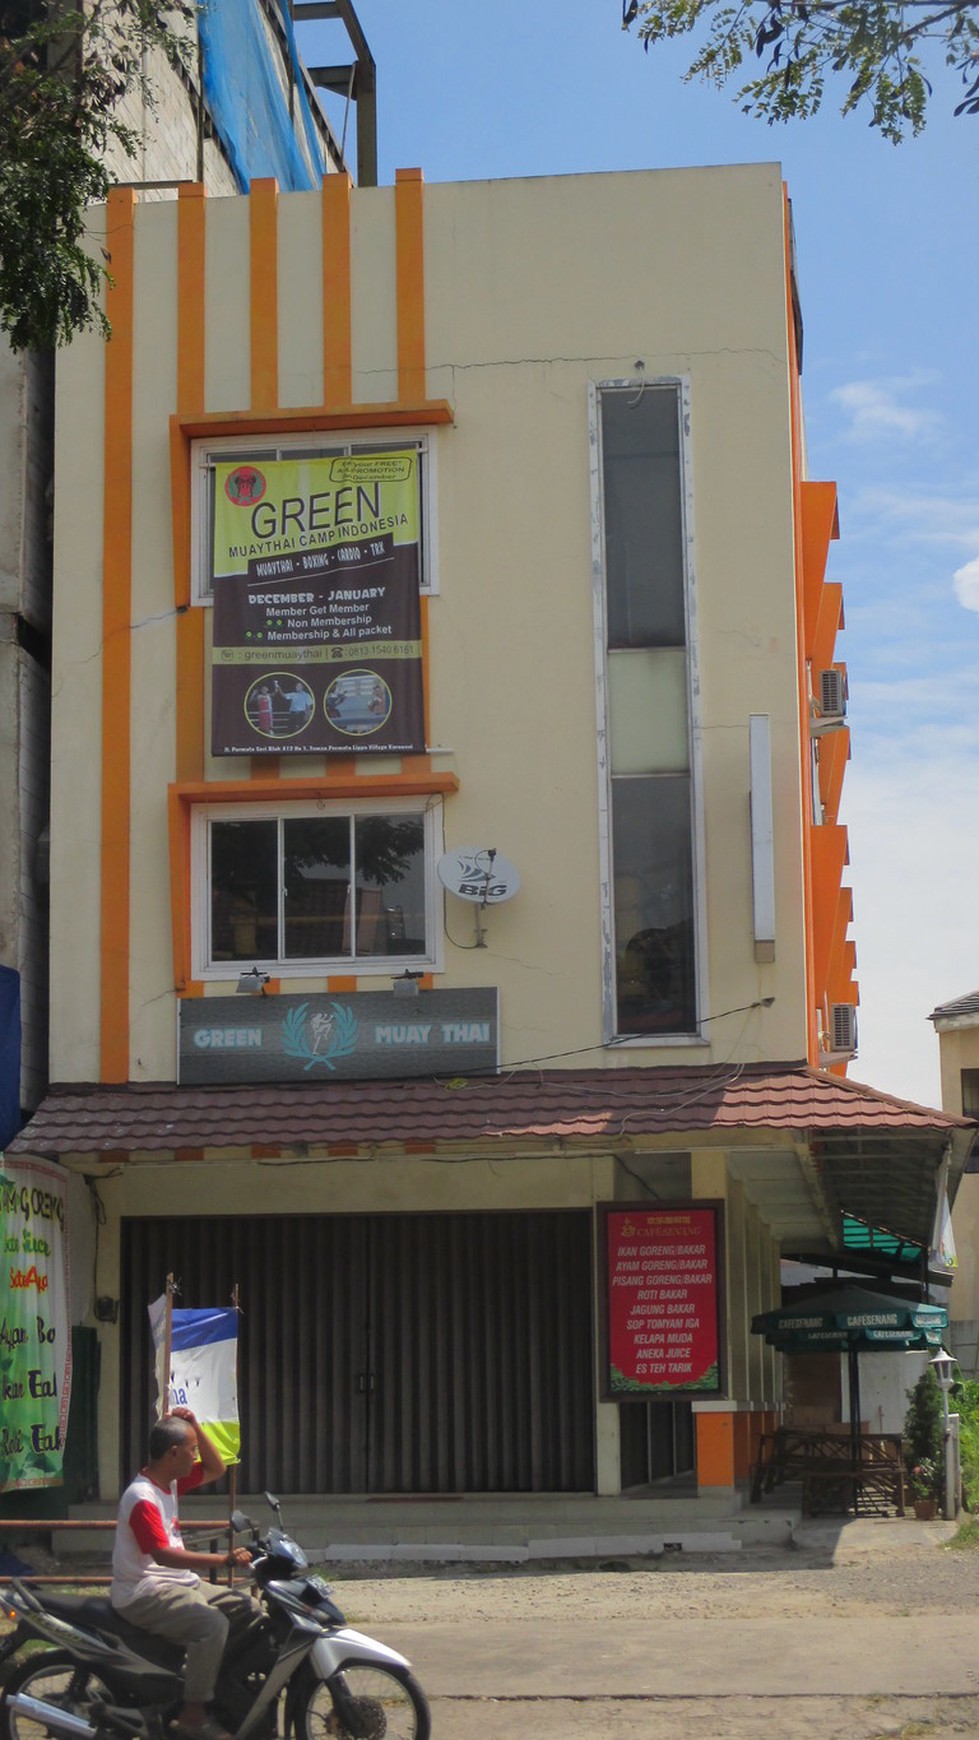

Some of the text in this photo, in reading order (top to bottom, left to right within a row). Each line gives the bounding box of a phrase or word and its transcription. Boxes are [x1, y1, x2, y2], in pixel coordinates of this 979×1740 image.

[250, 482, 381, 539] GREEN
[229, 513, 409, 559] MUAYTHAI CAMP INDONESIA
[256, 541, 386, 578] MUAYTHAI BOXING CARDIO TRX
[248, 592, 314, 604] DECEMBER
[327, 586, 386, 601] JANUARY
[266, 602, 370, 617] Member Get Member
[287, 613, 372, 628] Non Membership
[267, 624, 392, 641] Membership & All packet
[244, 648, 323, 661] greenmuaythai
[193, 1022, 491, 1048] GREEN MUAY THAI
[617, 1246, 638, 1257] IKAN
[616, 1260, 640, 1272] AYAM
[612, 1275, 644, 1287] PISANG
[636, 1288, 688, 1300] ROTI BAKAR
[630, 1303, 695, 1316] JAGUNG BAKAR
[626, 1317, 700, 1331] SOP TOMYAM IGA
[633, 1332, 693, 1345] KELAPA MUDA
[635, 1347, 691, 1360] ANEKA JUICE
[635, 1362, 693, 1375] ES TEH TARIK
